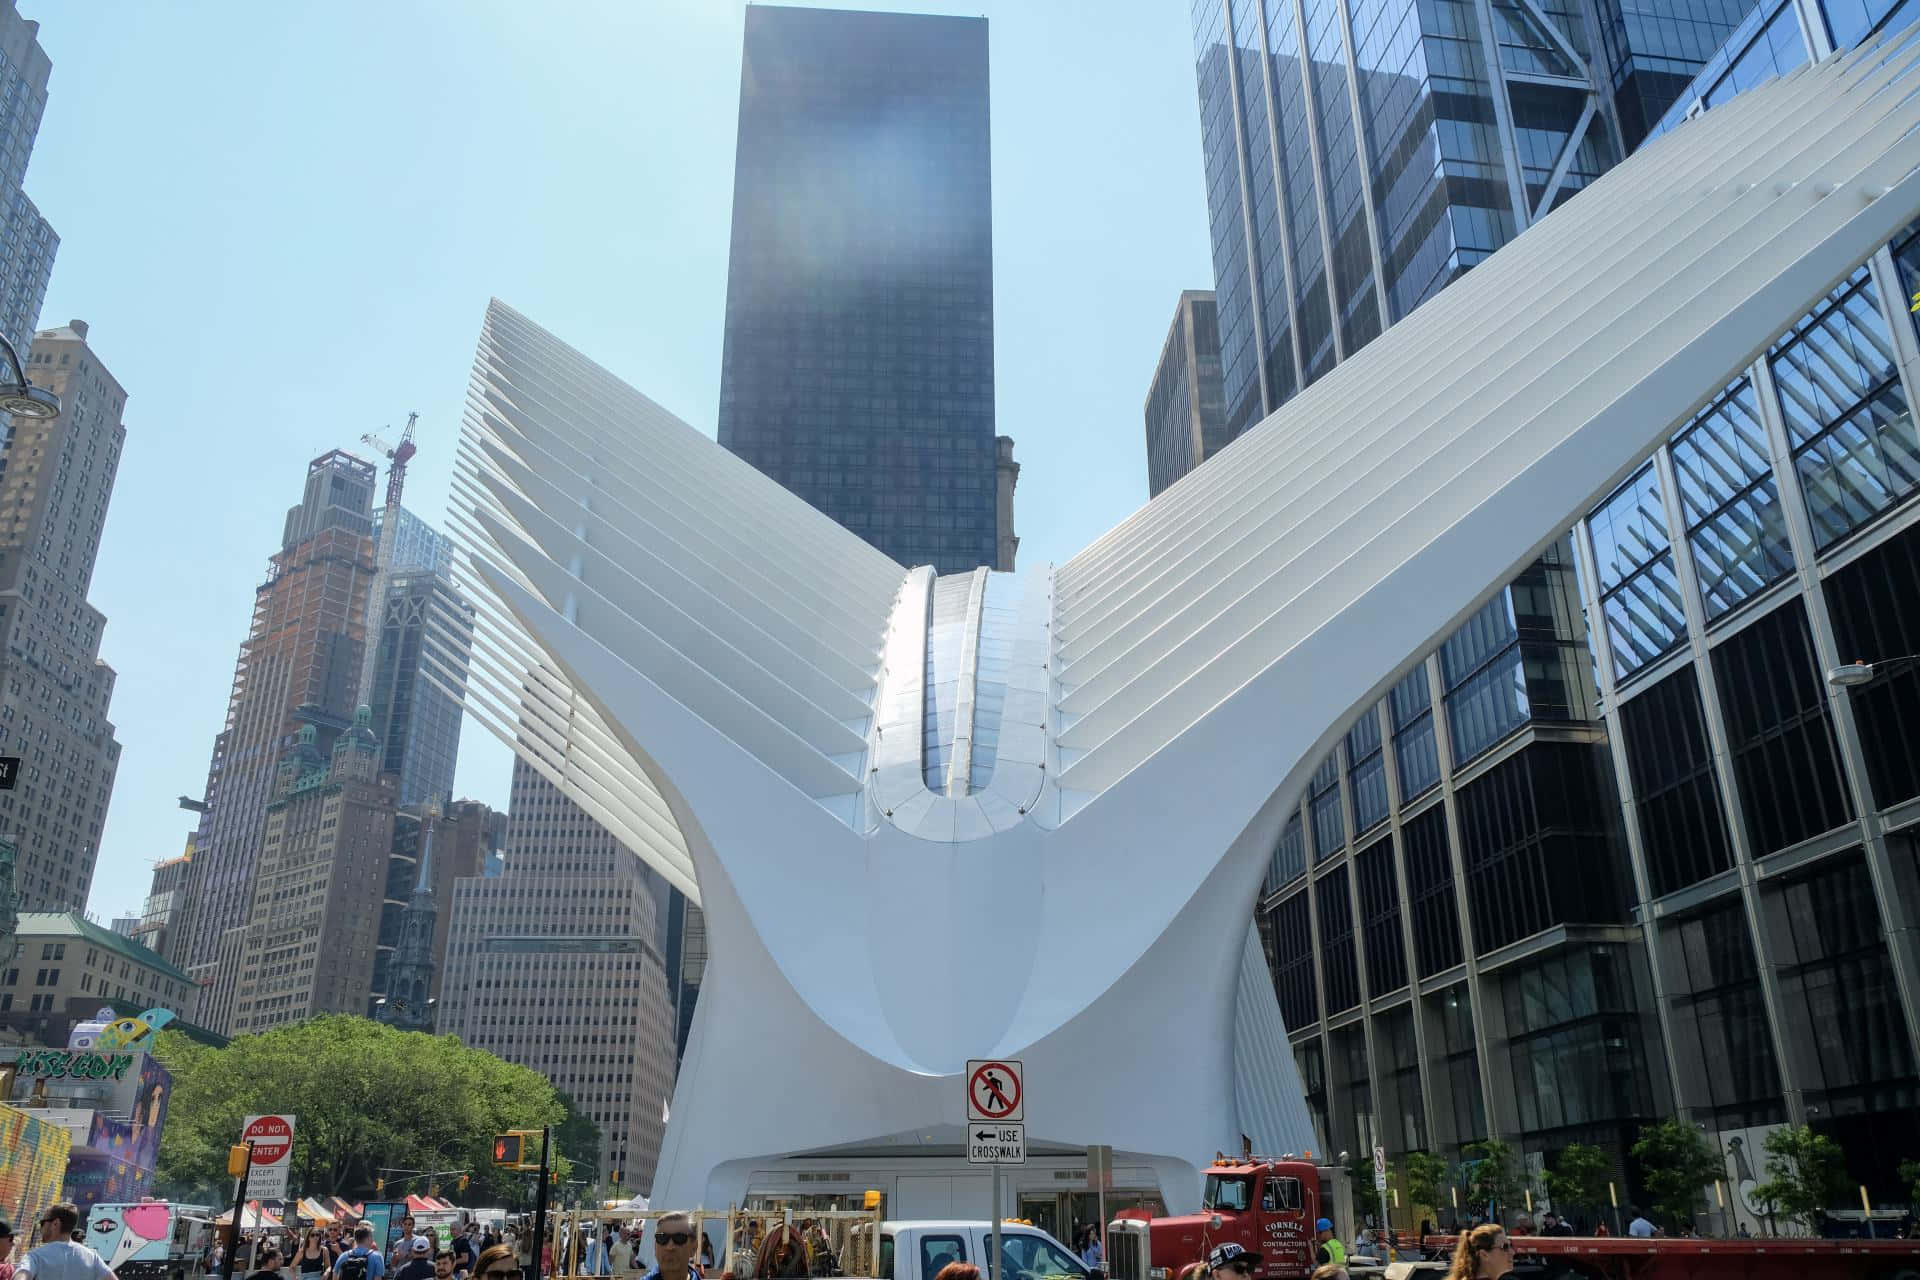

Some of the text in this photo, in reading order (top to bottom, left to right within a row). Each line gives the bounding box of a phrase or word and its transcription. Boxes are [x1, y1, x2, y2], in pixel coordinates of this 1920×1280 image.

[251, 1125, 286, 1134] DO NOT
[999, 1130, 1018, 1142] USE
[252, 1147, 280, 1156] ENTER
[972, 1145, 1021, 1158] CROSSWALK
[250, 1169, 274, 1177] EXCEPT
[247, 1178, 281, 1187] UTHORIZED
[1264, 1221, 1304, 1232] CORNELL
